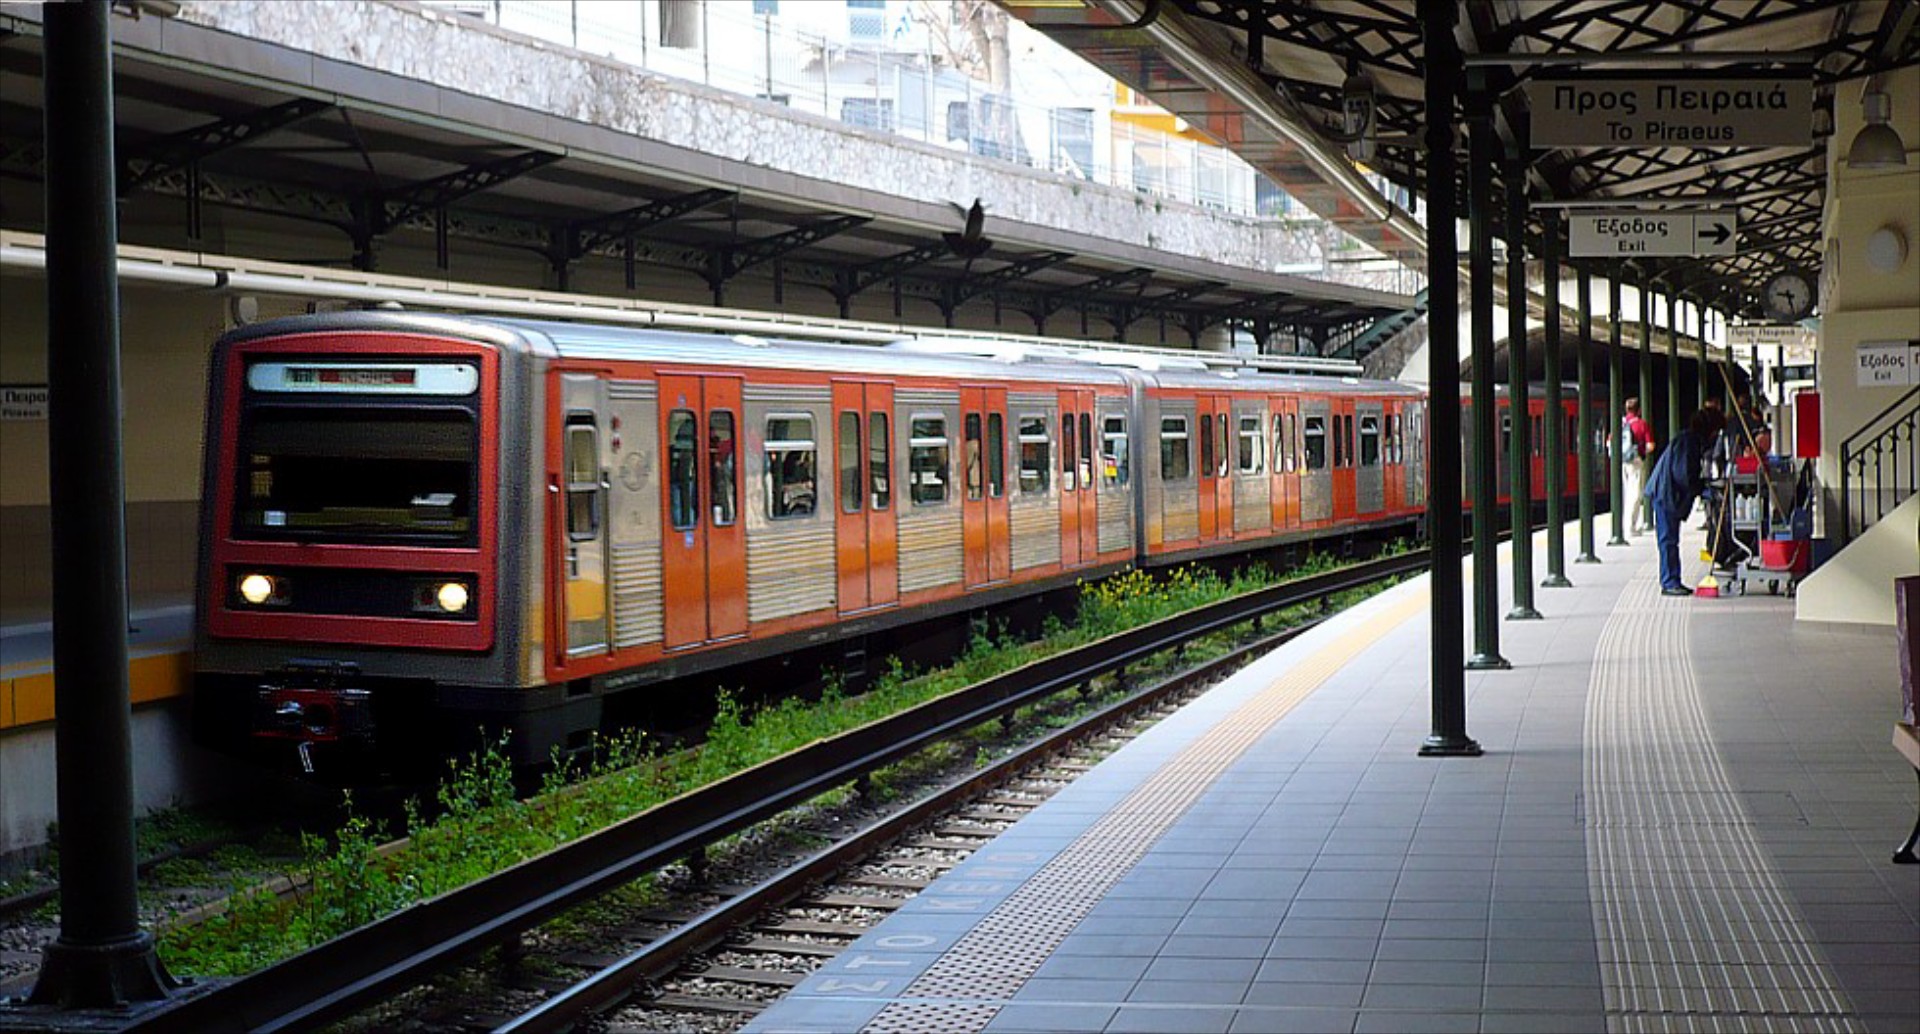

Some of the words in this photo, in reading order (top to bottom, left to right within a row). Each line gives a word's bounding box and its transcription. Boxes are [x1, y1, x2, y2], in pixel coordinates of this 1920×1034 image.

[1555, 86, 1636, 115] Προς
[1657, 82, 1788, 115] Πειραιά
[1606, 122, 1633, 140] To
[1645, 121, 1735, 141] Piraeus
[1593, 218, 1668, 237] Έξοδος
[1618, 240, 1646, 252] Exit
